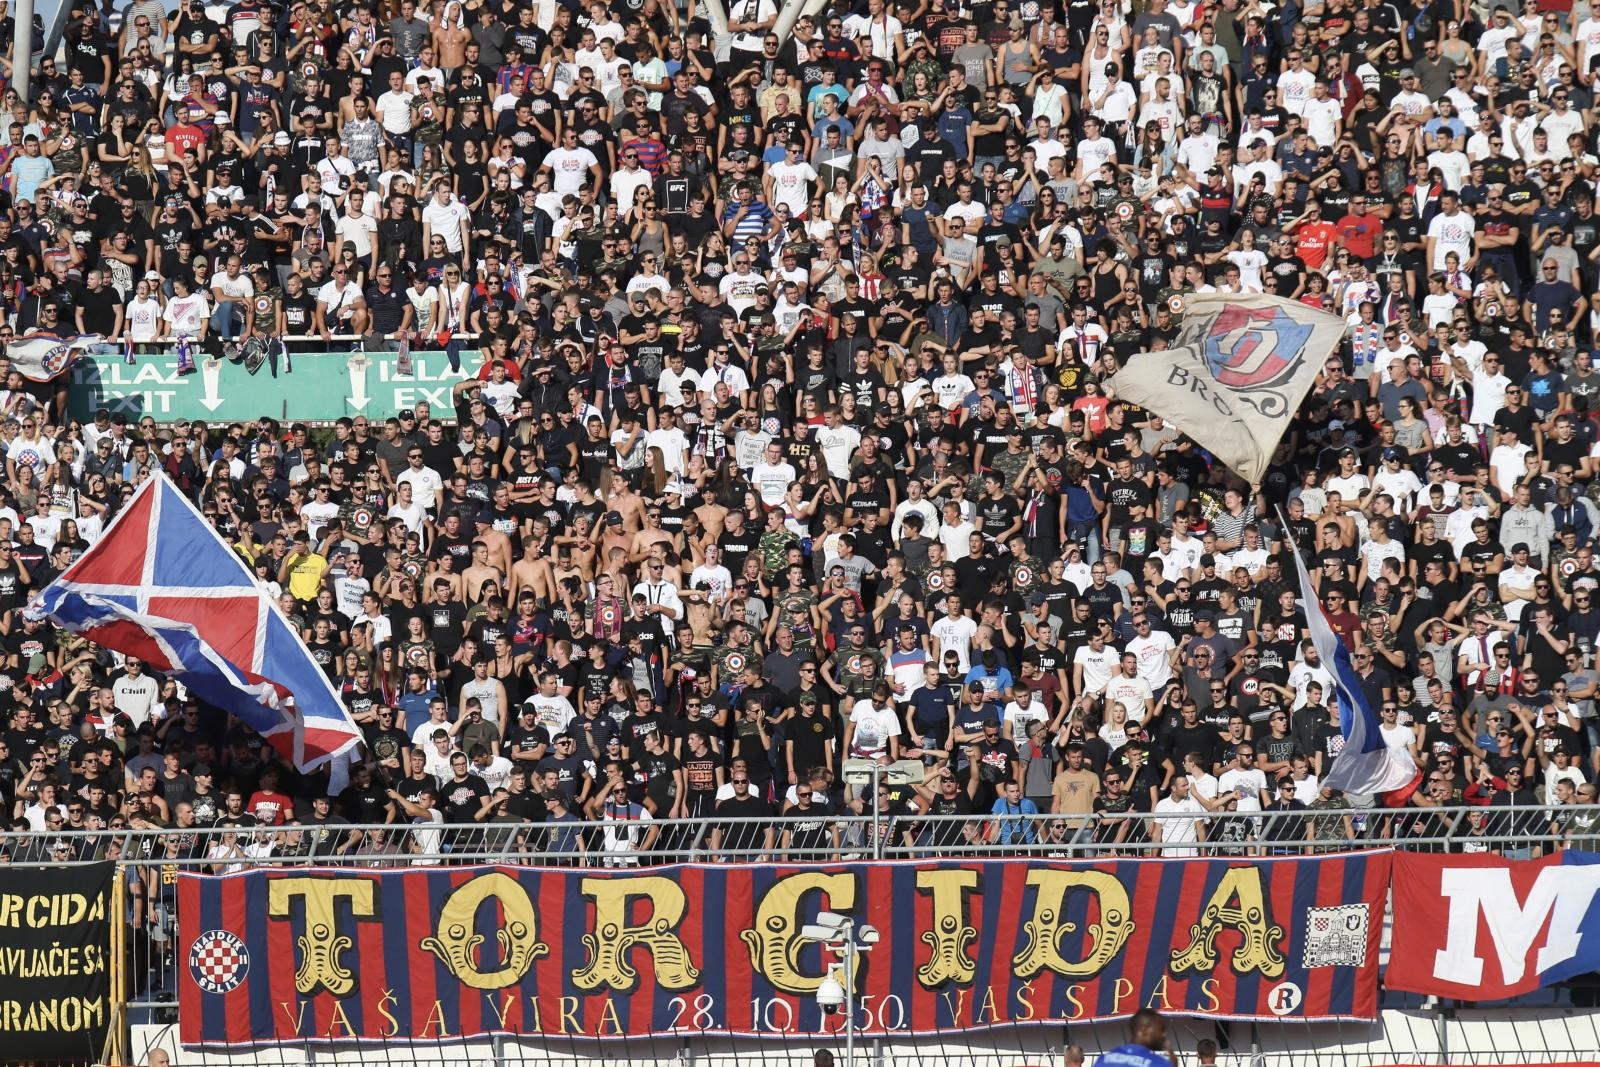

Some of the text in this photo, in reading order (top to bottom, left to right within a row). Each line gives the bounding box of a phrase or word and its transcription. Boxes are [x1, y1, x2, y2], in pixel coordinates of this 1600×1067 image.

[729, 115, 752, 124] NIKE
[74, 362, 190, 385] IZLAZ
[88, 390, 177, 413] EXIT
[393, 386, 456, 410] EXI
[515, 476, 531, 484] JUST
[638, 631, 655, 640] das
[121, 687, 147, 695] Chill
[1269, 743, 1294, 754] JUST
[0, 890, 105, 928] RCIDA
[193, 931, 243, 953] HAJDUK
[266, 866, 1287, 996] TORCIDA
[83, 944, 105, 976] SA
[198, 976, 239, 993] SPLIT
[0, 995, 104, 1032] RANOM
[485, 993, 623, 1036] VIRA
[667, 993, 722, 1033] 28.
[750, 997, 795, 1033] 10.
